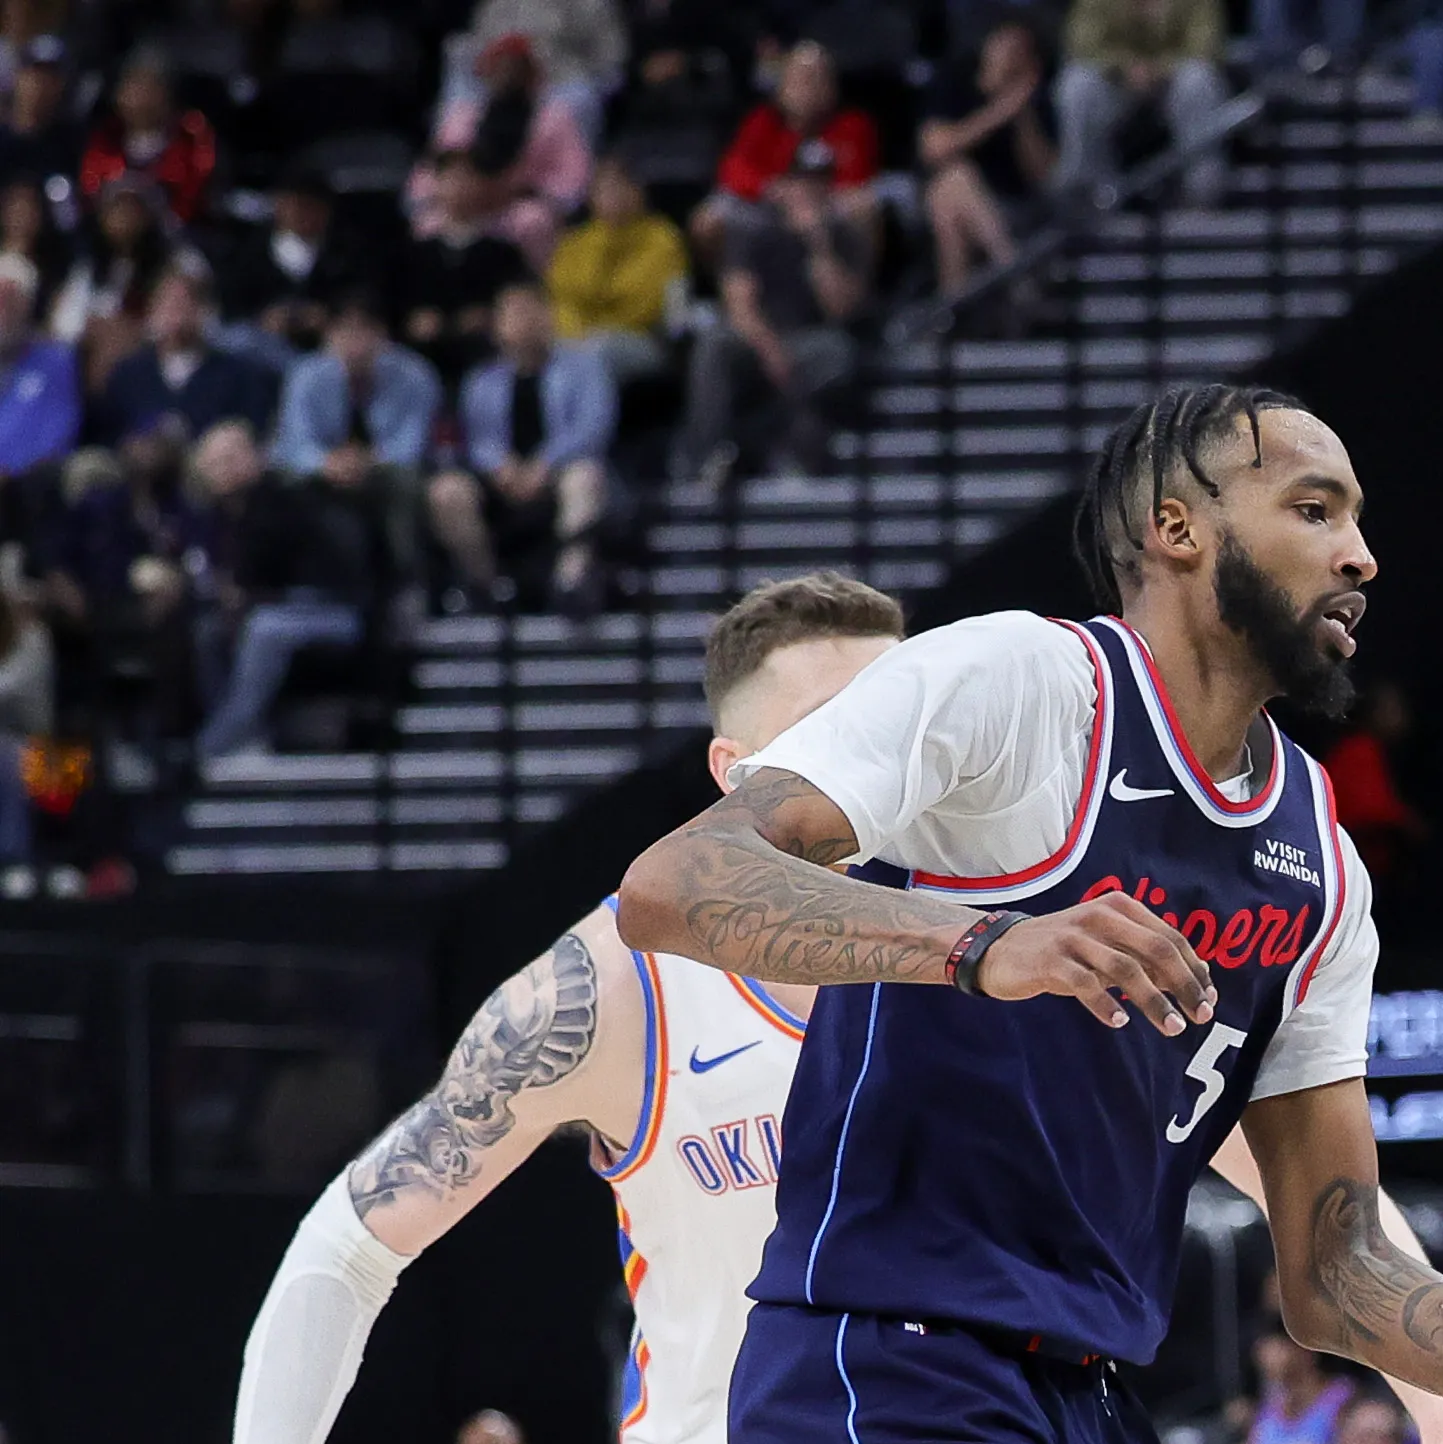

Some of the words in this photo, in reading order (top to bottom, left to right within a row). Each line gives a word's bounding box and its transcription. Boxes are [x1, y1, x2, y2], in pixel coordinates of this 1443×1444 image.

[1253, 850, 1321, 888] RWANDA
[1265, 838, 1307, 866] VISIT
[1165, 1021, 1248, 1144] 5
